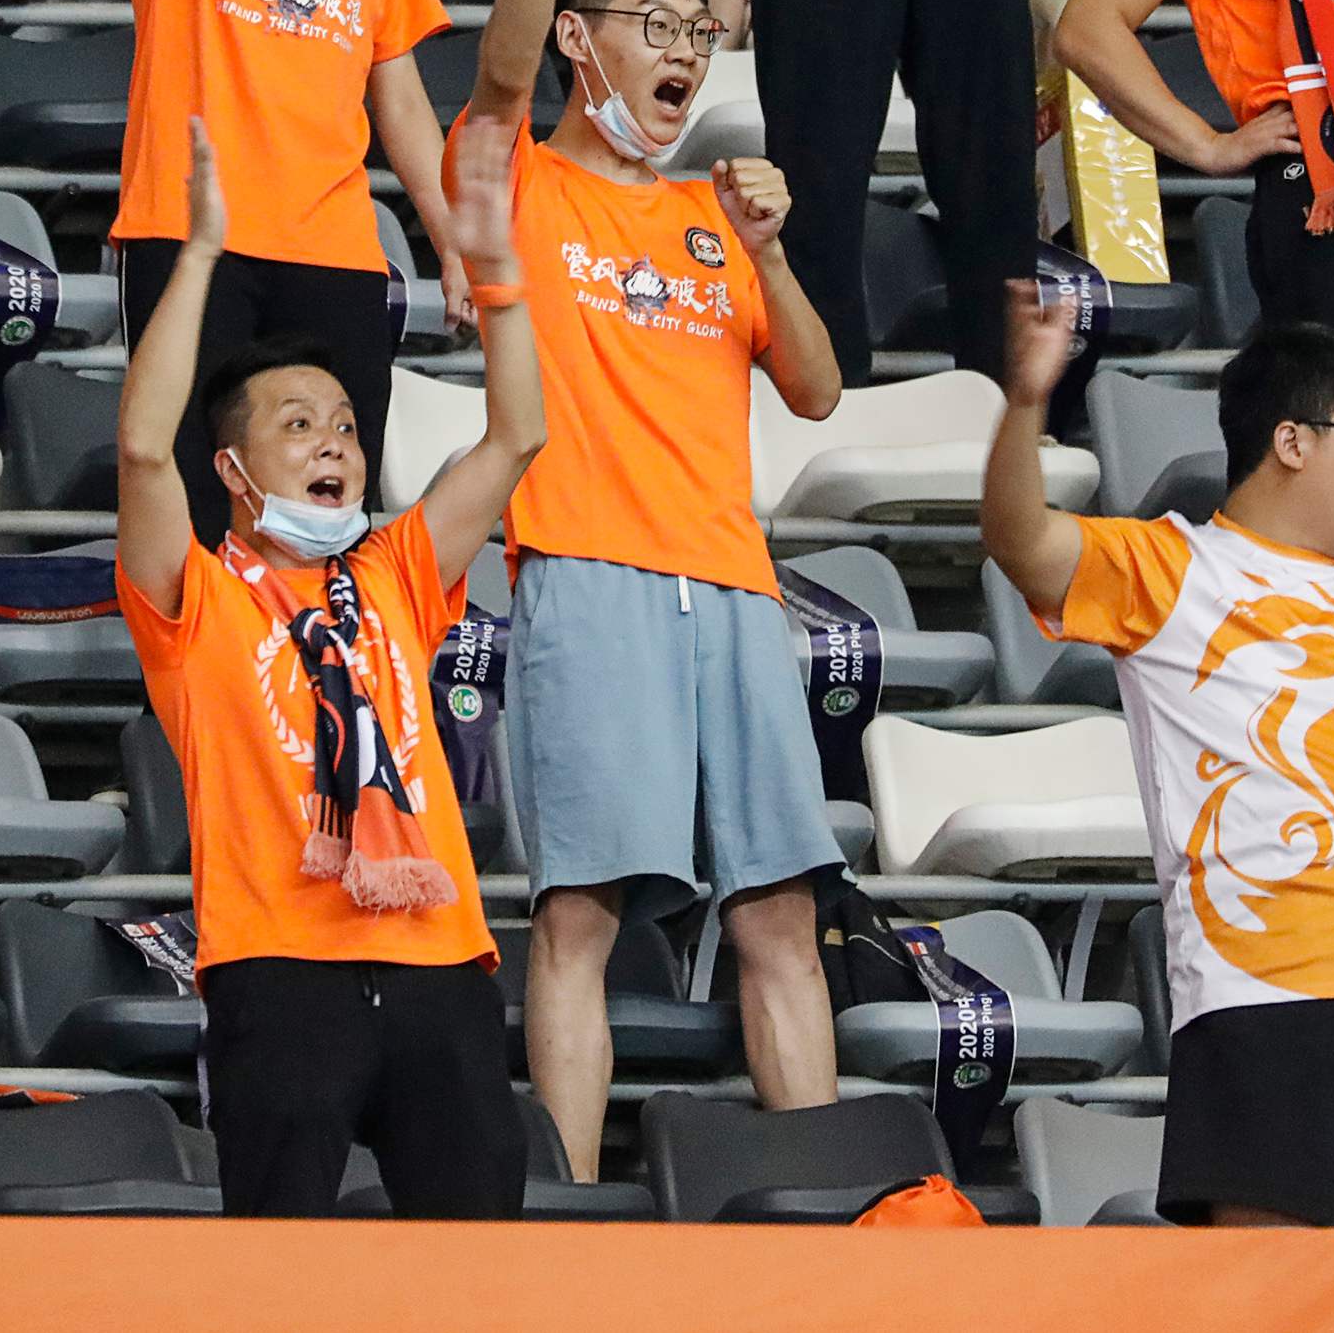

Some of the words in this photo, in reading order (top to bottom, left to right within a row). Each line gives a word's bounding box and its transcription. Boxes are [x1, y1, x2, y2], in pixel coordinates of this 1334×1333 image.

[269, 15, 296, 33] THE
[301, 22, 329, 40] CITY
[7, 266, 27, 311] 2020
[652, 313, 681, 331] CITY
[686, 320, 725, 340] GLORY
[481, 623, 495, 652] Ping
[850, 623, 862, 651] Ping
[475, 652, 488, 682] 2020
[851, 652, 863, 682] 2020
[982, 997, 994, 1025] Ping
[982, 1026, 995, 1058] 2020
